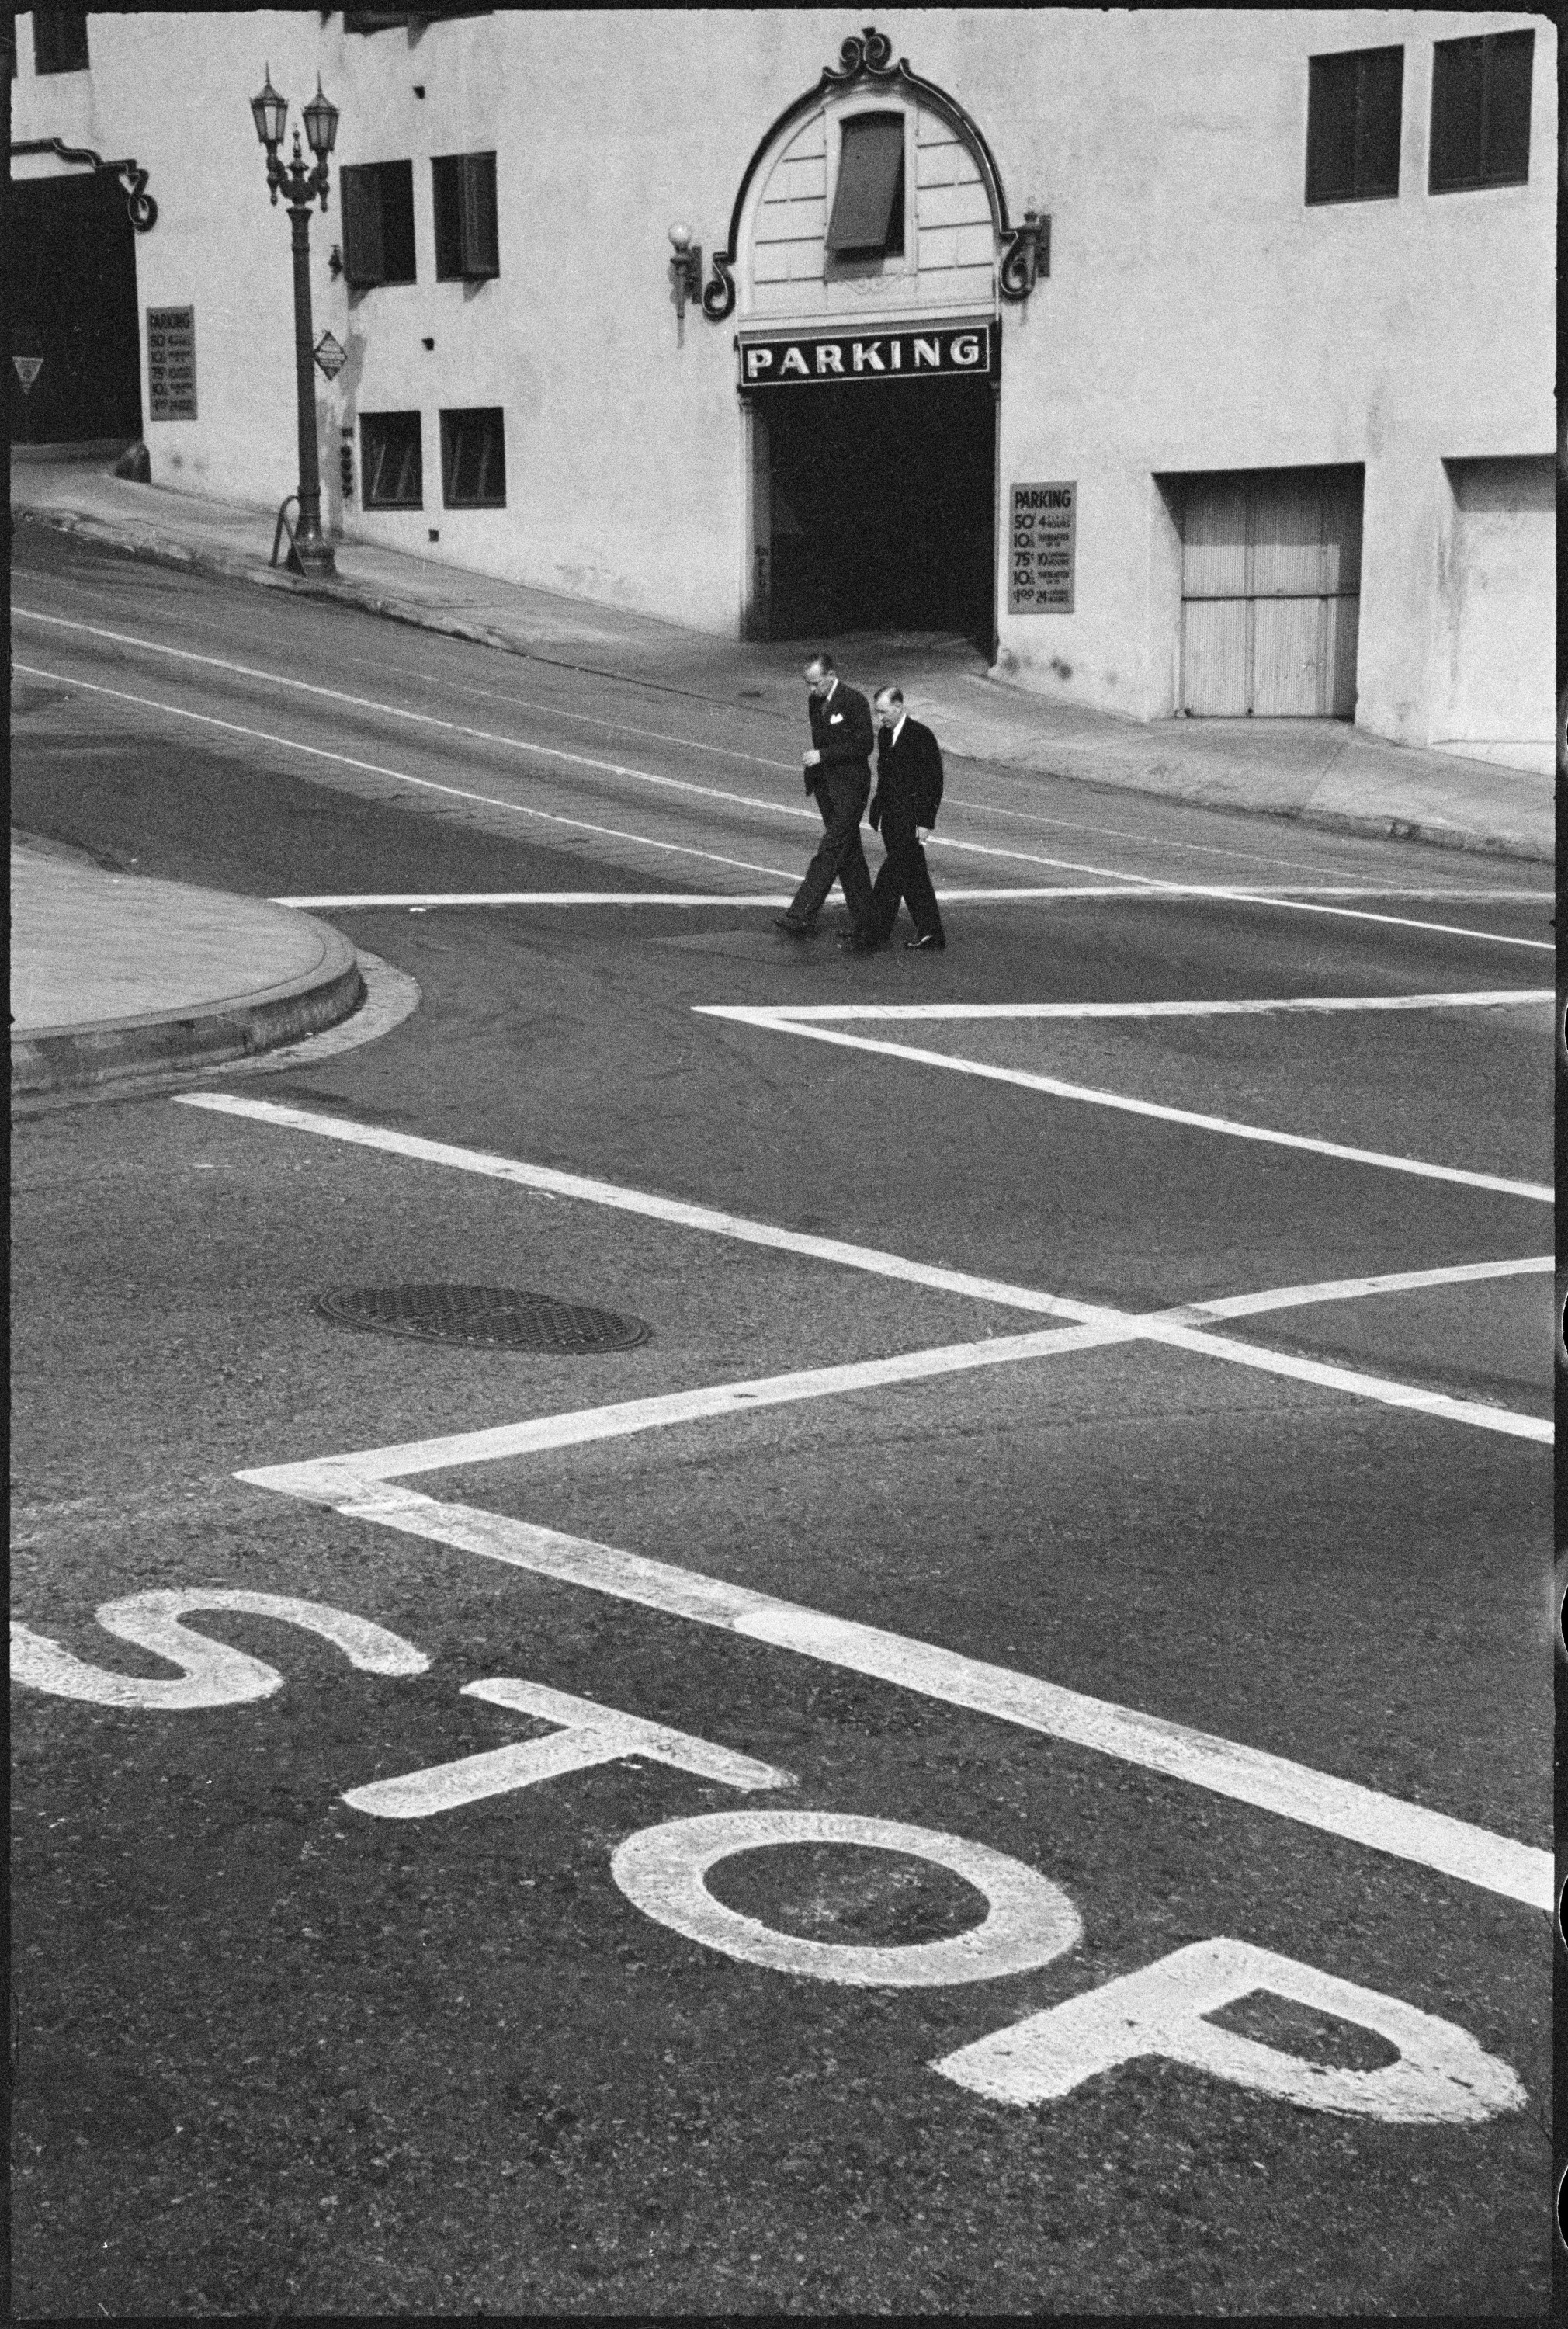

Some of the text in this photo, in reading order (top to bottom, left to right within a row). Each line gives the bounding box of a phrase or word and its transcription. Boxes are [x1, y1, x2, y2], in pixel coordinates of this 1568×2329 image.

[150, 312, 191, 330] PARKING
[747, 335, 980, 378] PARKING
[1015, 489, 1071, 509] PARKING
[1038, 515, 1046, 529] 4
[1037, 552, 1048, 566] 10
[9, 1587, 1529, 2126] STOP
